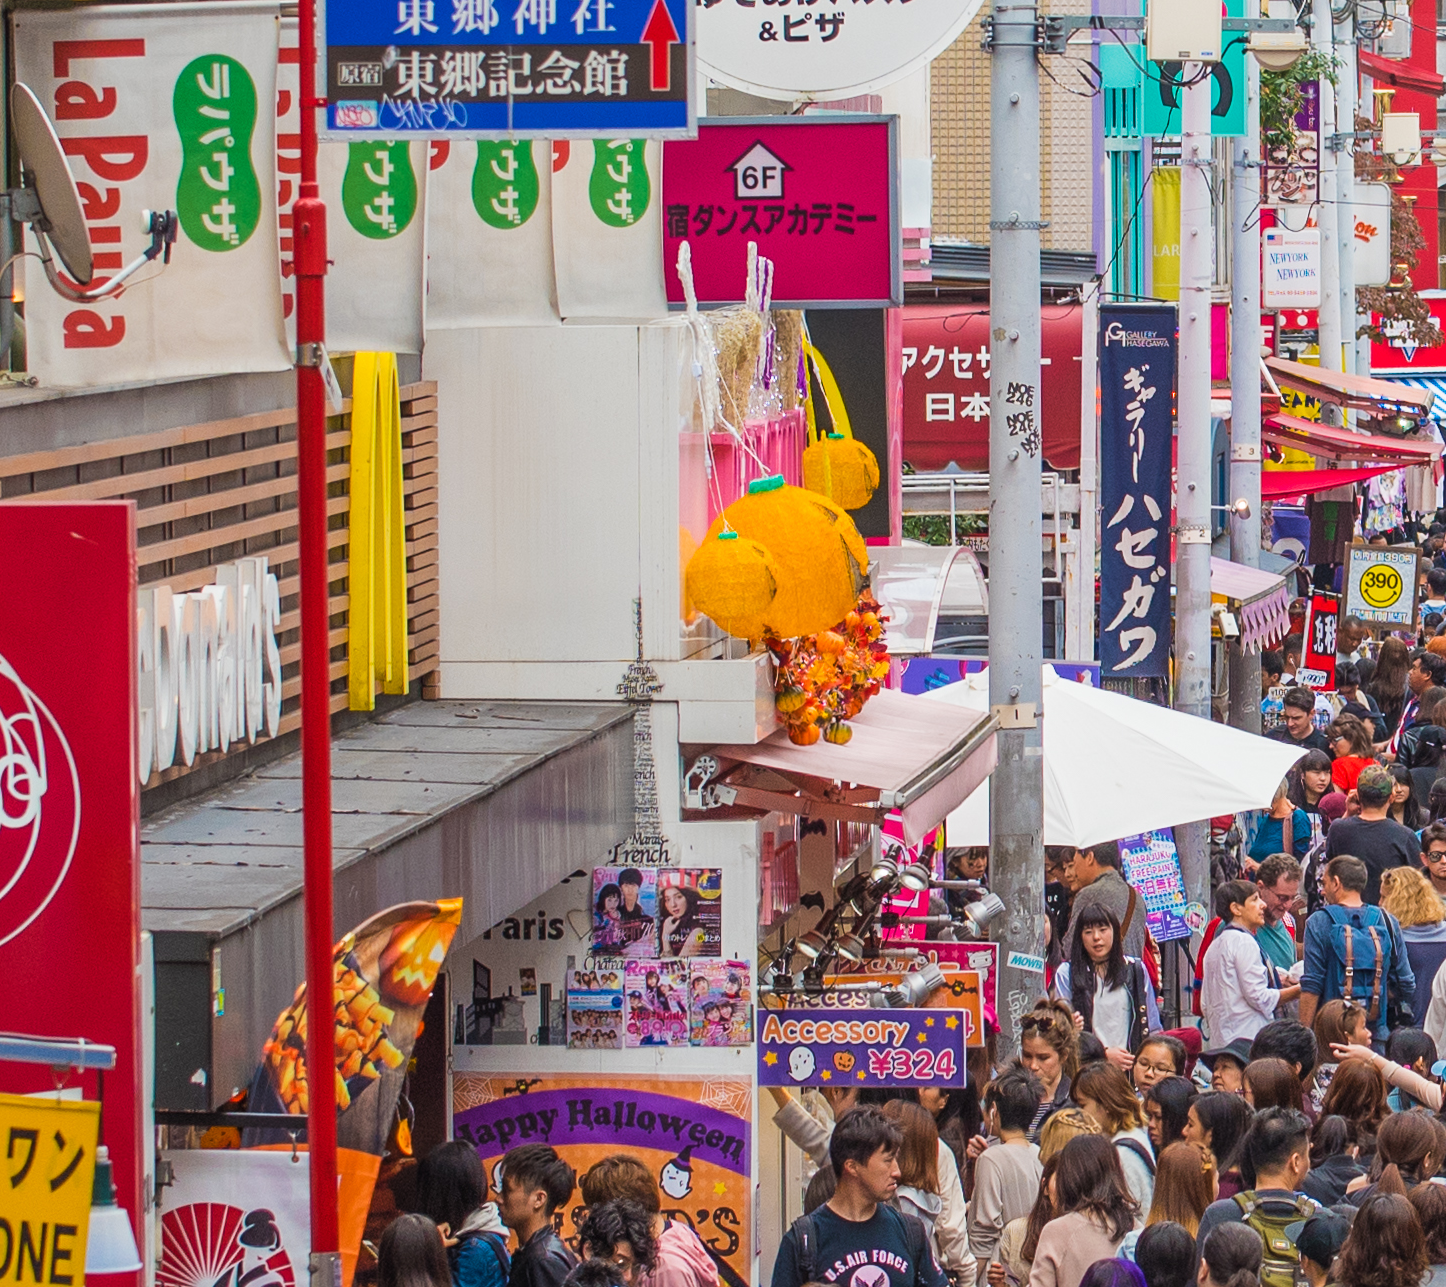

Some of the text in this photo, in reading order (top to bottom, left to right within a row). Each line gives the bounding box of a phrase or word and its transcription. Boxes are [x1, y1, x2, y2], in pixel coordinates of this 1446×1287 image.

[759, 15, 846, 43] &ピザ
[394, 49, 629, 99] 東郷記念館
[196, 61, 242, 247] ラパウザ
[741, 166, 777, 190] 6F
[1122, 364, 1159, 485] ギャラリー
[1106, 493, 1163, 671] ハセガワ
[1365, 571, 1400, 589] 390
[763, 1019, 910, 1046] Accessory
[870, 1050, 956, 1079] ¥324
[565, 1098, 744, 1165] Halloween
[871, 1250, 909, 1273] FORCE
